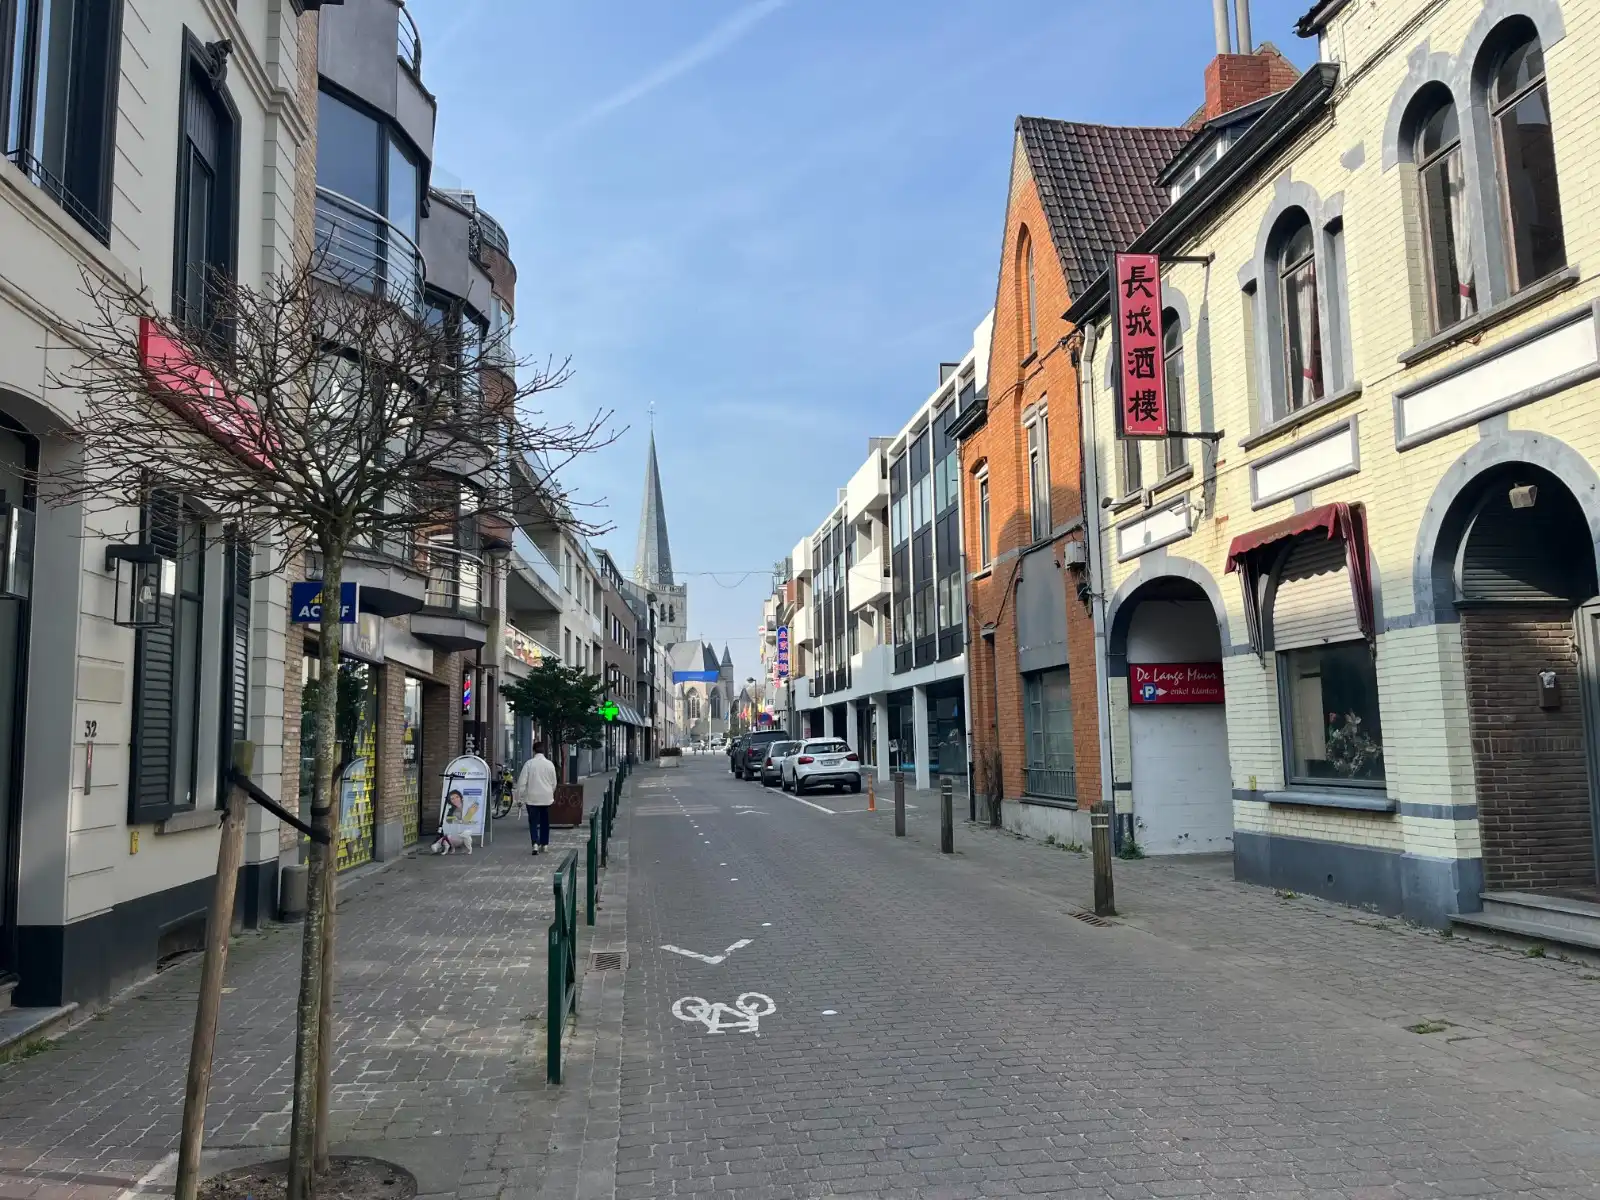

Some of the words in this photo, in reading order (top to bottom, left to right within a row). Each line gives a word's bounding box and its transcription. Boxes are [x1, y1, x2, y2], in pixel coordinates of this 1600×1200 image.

[1121, 264, 1159, 422] 長城酒樓
[298, 605, 350, 617] ACF
[1136, 667, 1150, 682] De
[1153, 667, 1184, 685] Lange
[1170, 687, 1189, 695] enkel
[1191, 686, 1218, 695] klanten
[84, 720, 97, 738] 32
